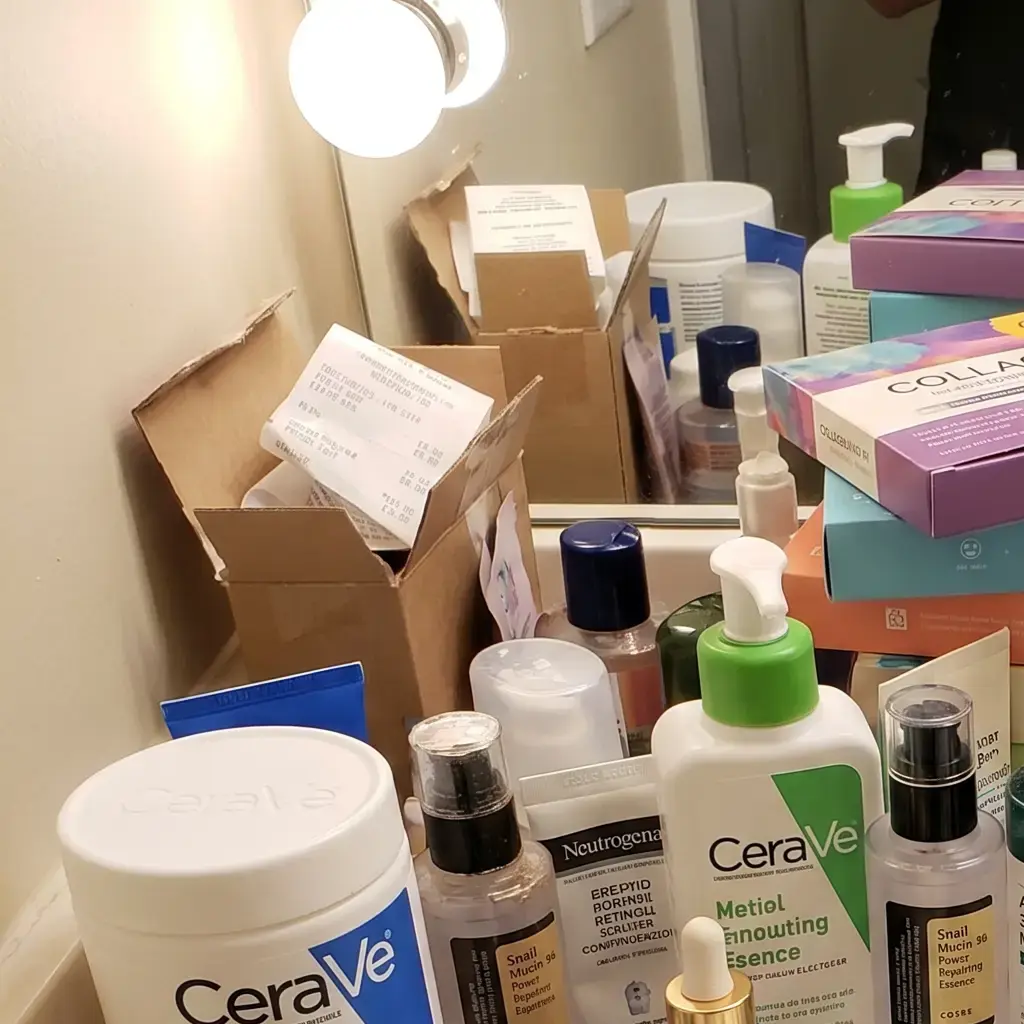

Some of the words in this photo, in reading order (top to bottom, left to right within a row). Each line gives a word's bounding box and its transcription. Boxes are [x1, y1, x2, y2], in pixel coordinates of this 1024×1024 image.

[709, 820, 858, 872] CeraVe
[937, 925, 968, 940] Snail
[938, 940, 972, 953] Mucin
[507, 946, 538, 967] Snail
[509, 962, 544, 980] Mucin
[939, 977, 976, 989] Essence
